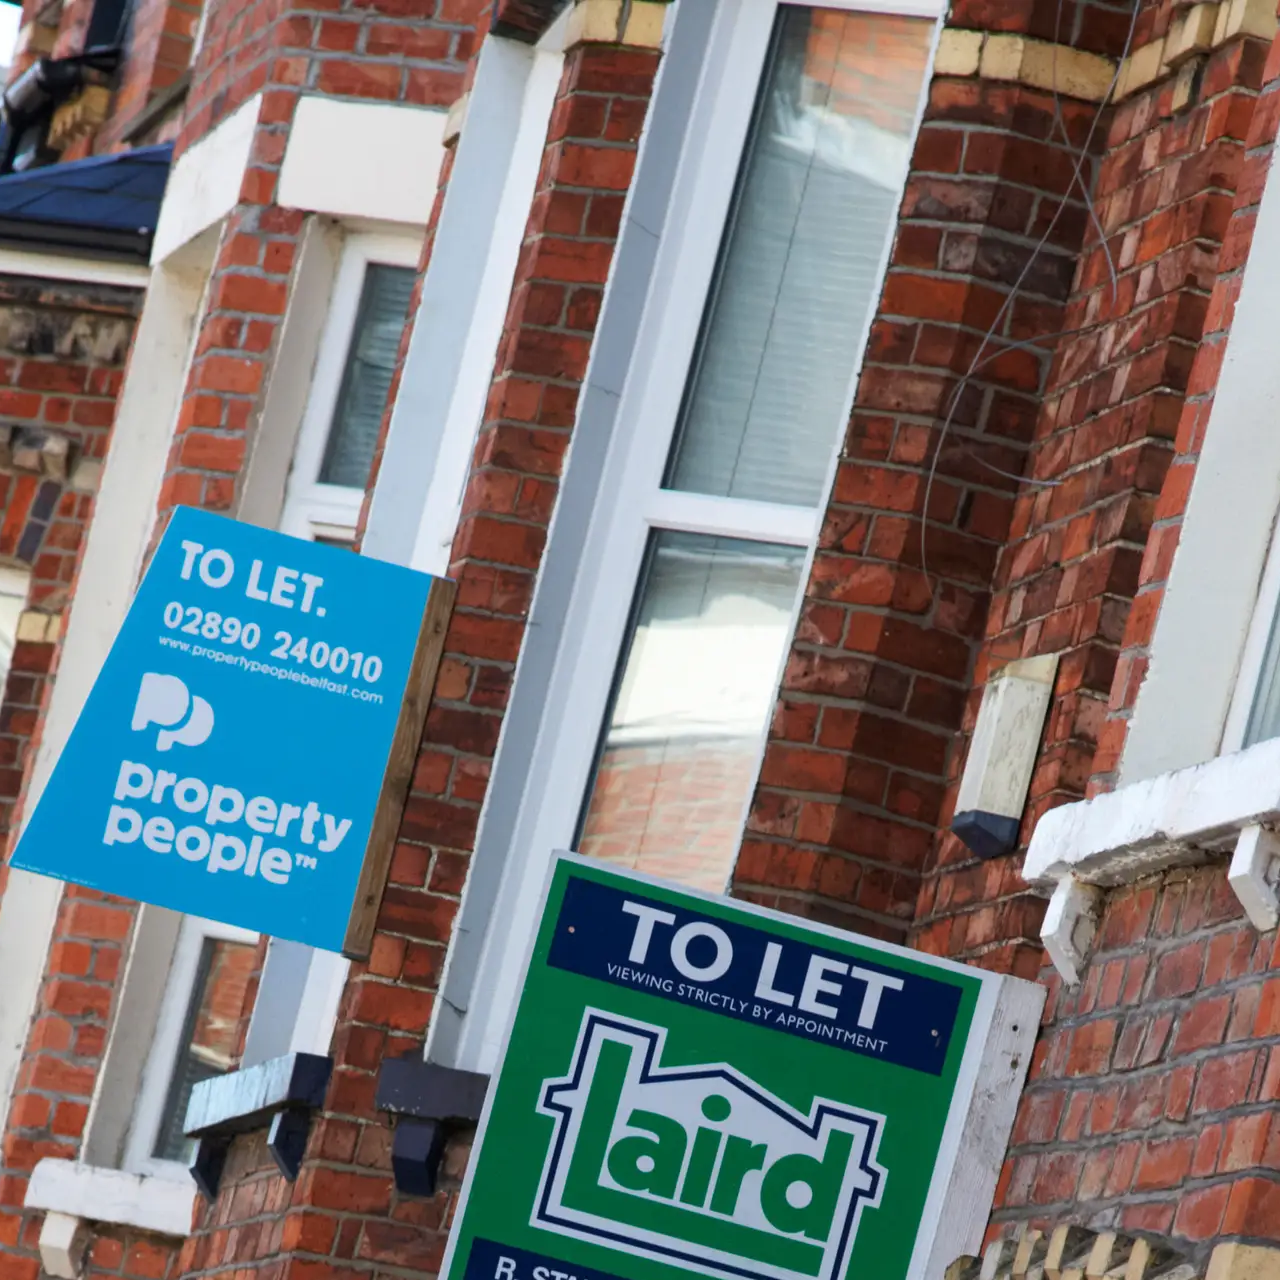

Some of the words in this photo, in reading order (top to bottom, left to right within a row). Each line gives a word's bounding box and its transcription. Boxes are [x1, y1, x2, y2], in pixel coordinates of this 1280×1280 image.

[179, 540, 234, 588] TO
[245, 560, 326, 617] LET.
[158, 635, 383, 705] www.propertypeoplebelfast.com
[163, 601, 261, 650] 02890
[270, 631, 383, 683] 240010
[113, 760, 353, 853] property
[607, 962, 673, 994] VIEWING
[677, 983, 749, 1015] STRICTLY
[752, 1003, 773, 1021] BY
[775, 1010, 888, 1053] APPOINTMENT
[622, 901, 733, 982] TO
[754, 943, 904, 1029] LET
